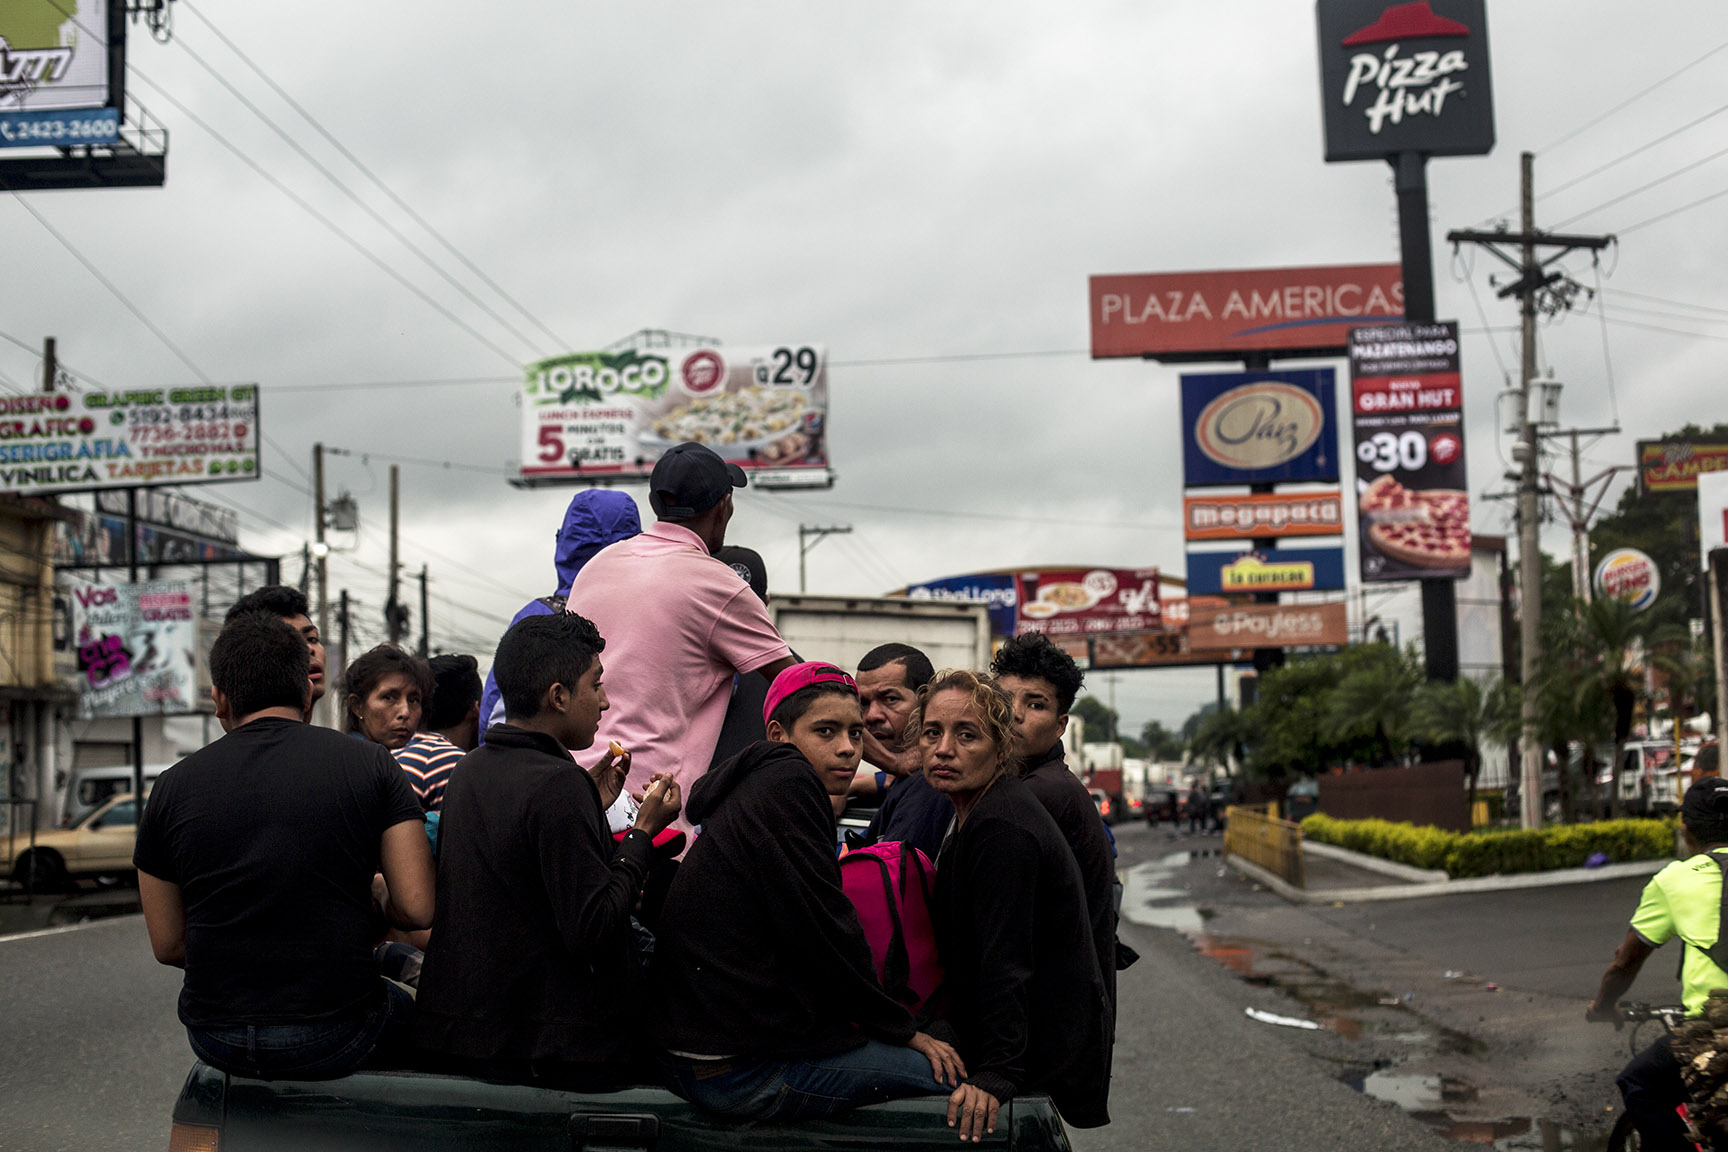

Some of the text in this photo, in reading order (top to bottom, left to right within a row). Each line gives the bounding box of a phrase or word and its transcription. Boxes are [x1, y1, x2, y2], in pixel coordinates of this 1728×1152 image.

[1342, 43, 1469, 106] Pizza
[1364, 77, 1464, 134] Hut
[17, 120, 116, 138] 2423-2600
[1101, 283, 1404, 325] PLAZA AMERICAS
[1352, 340, 1457, 358] MAZATENANGO
[537, 360, 664, 398] LOROCO
[168, 387, 227, 404] GREEN
[1360, 388, 1455, 411] GRAN HUT
[1214, 395, 1298, 458] Paiz
[0, 438, 132, 465] SERIGRAFIA
[538, 424, 565, 463] 5
[567, 447, 625, 462] GRATIS
[105, 459, 204, 482] TARJETAS
[1193, 502, 1337, 525] megapaca
[1603, 561, 1651, 598] BURGER KING
[75, 586, 118, 609] Vos
[1234, 612, 1323, 638] Payless
